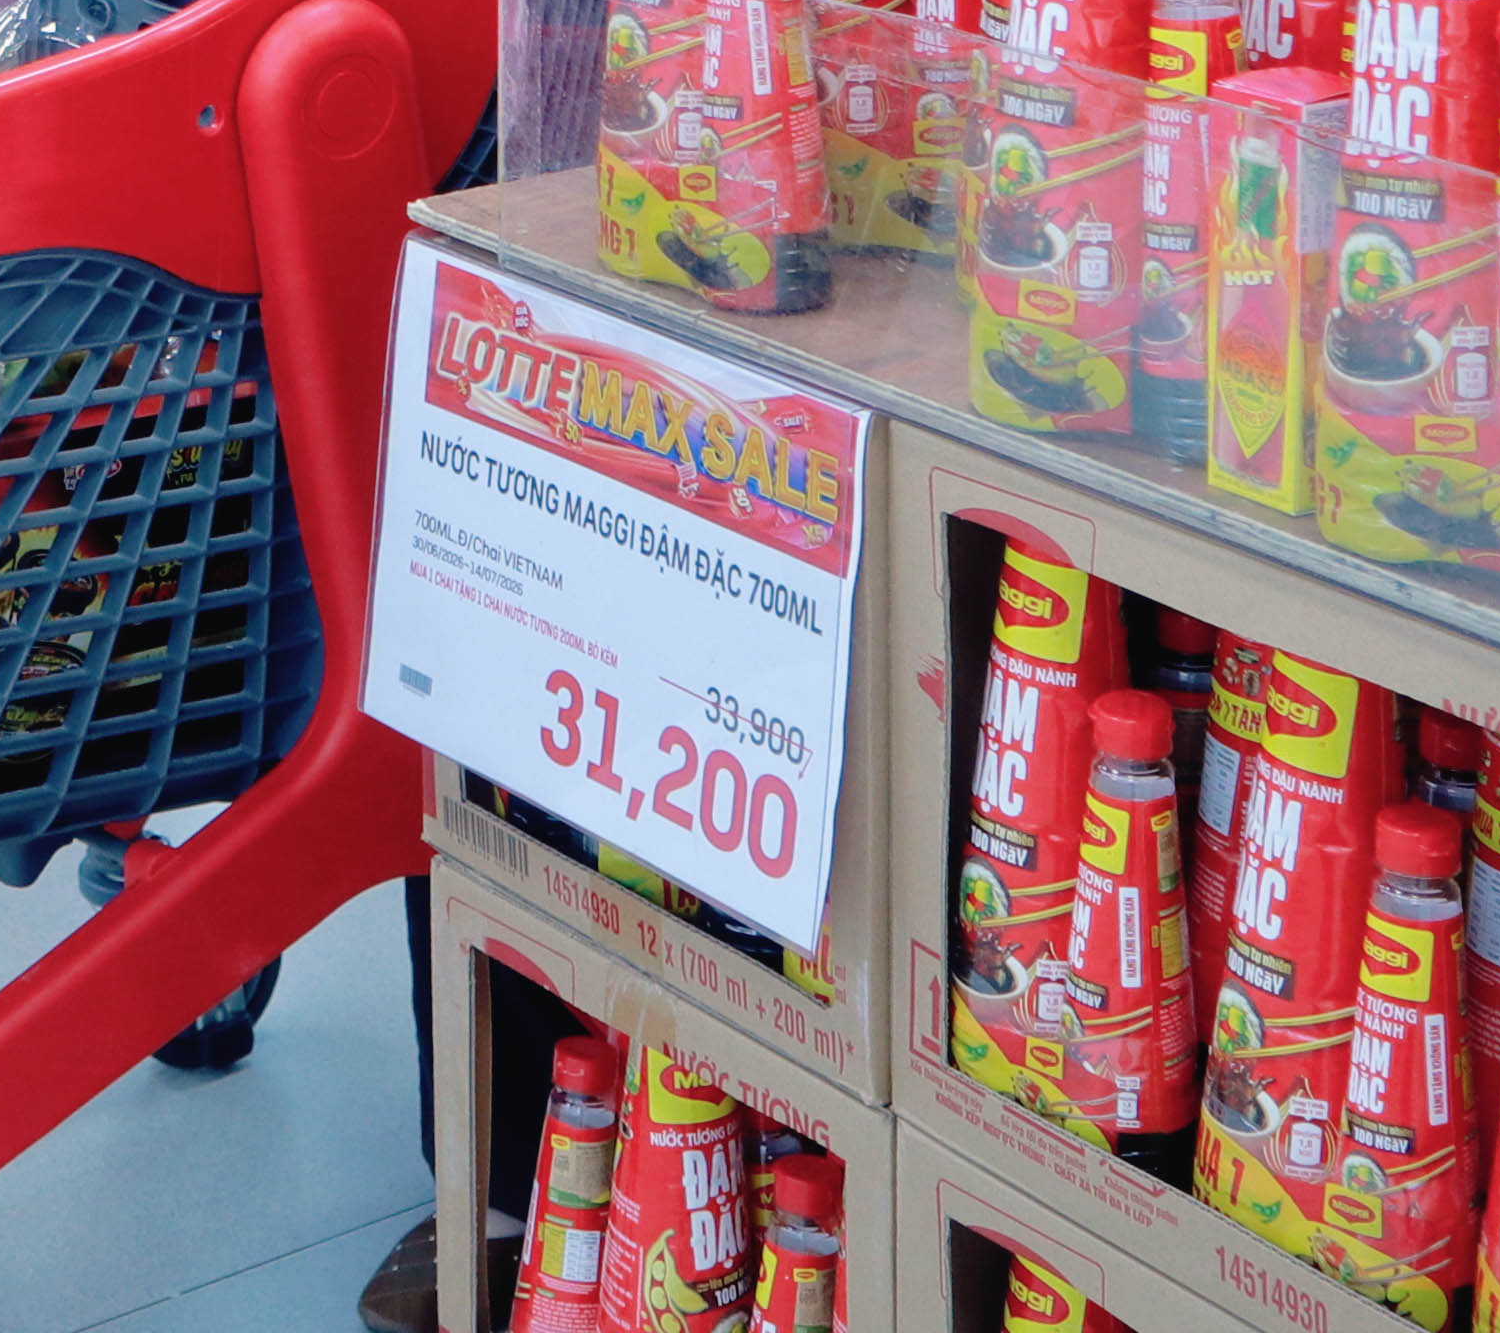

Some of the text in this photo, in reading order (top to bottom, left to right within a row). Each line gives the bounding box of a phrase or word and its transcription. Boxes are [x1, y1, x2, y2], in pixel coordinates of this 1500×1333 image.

[1223, 268, 1275, 287] HOT
[434, 317, 840, 525] LOTTE MAX SALE
[420, 430, 823, 635] NƯỚC TƯƠNG MAGGI ĐẬM ĐẶC 700ML
[504, 548, 563, 591] VIETNAM
[409, 560, 427, 579] MUA
[434, 572, 454, 592] CHAI
[483, 593, 503, 614] CHAI
[530, 613, 559, 640] TƯƠNG
[560, 629, 586, 654] 200ML
[704, 685, 805, 765] 33,900
[539, 669, 798, 880] 31,200
[542, 864, 621, 936] 14514930
[637, 919, 658, 958] 12
[680, 949, 719, 994] (700
[726, 980, 749, 1011] ml
[773, 1003, 806, 1046] 200
[649, 1131, 684, 1148] NƯỚC
